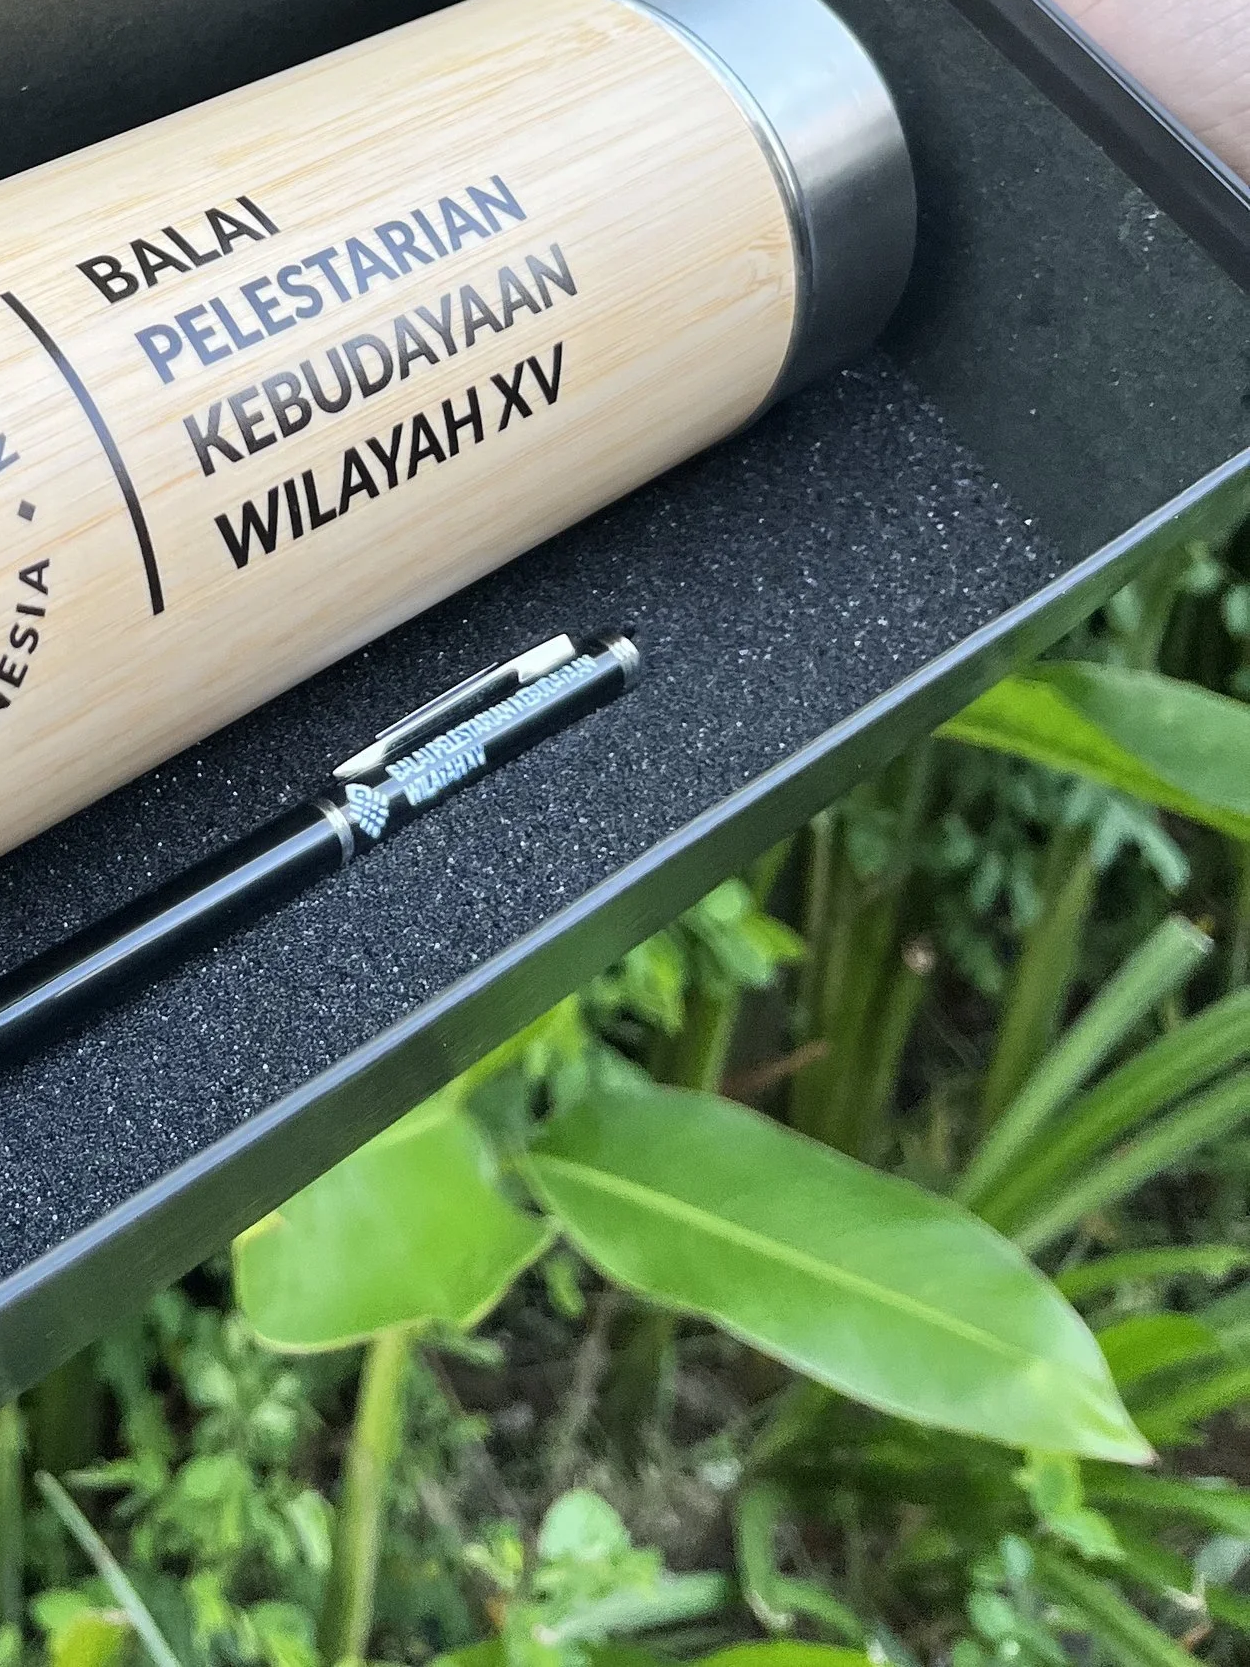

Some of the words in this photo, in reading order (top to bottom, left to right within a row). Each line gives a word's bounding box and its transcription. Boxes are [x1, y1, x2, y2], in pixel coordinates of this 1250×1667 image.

[76, 195, 281, 303] BALAI
[134, 174, 527, 384] PELESTARIAN
[182, 242, 578, 477] KEBUDAYAAN
[214, 386, 485, 570] WILAYAH
[497, 341, 564, 433] XV
